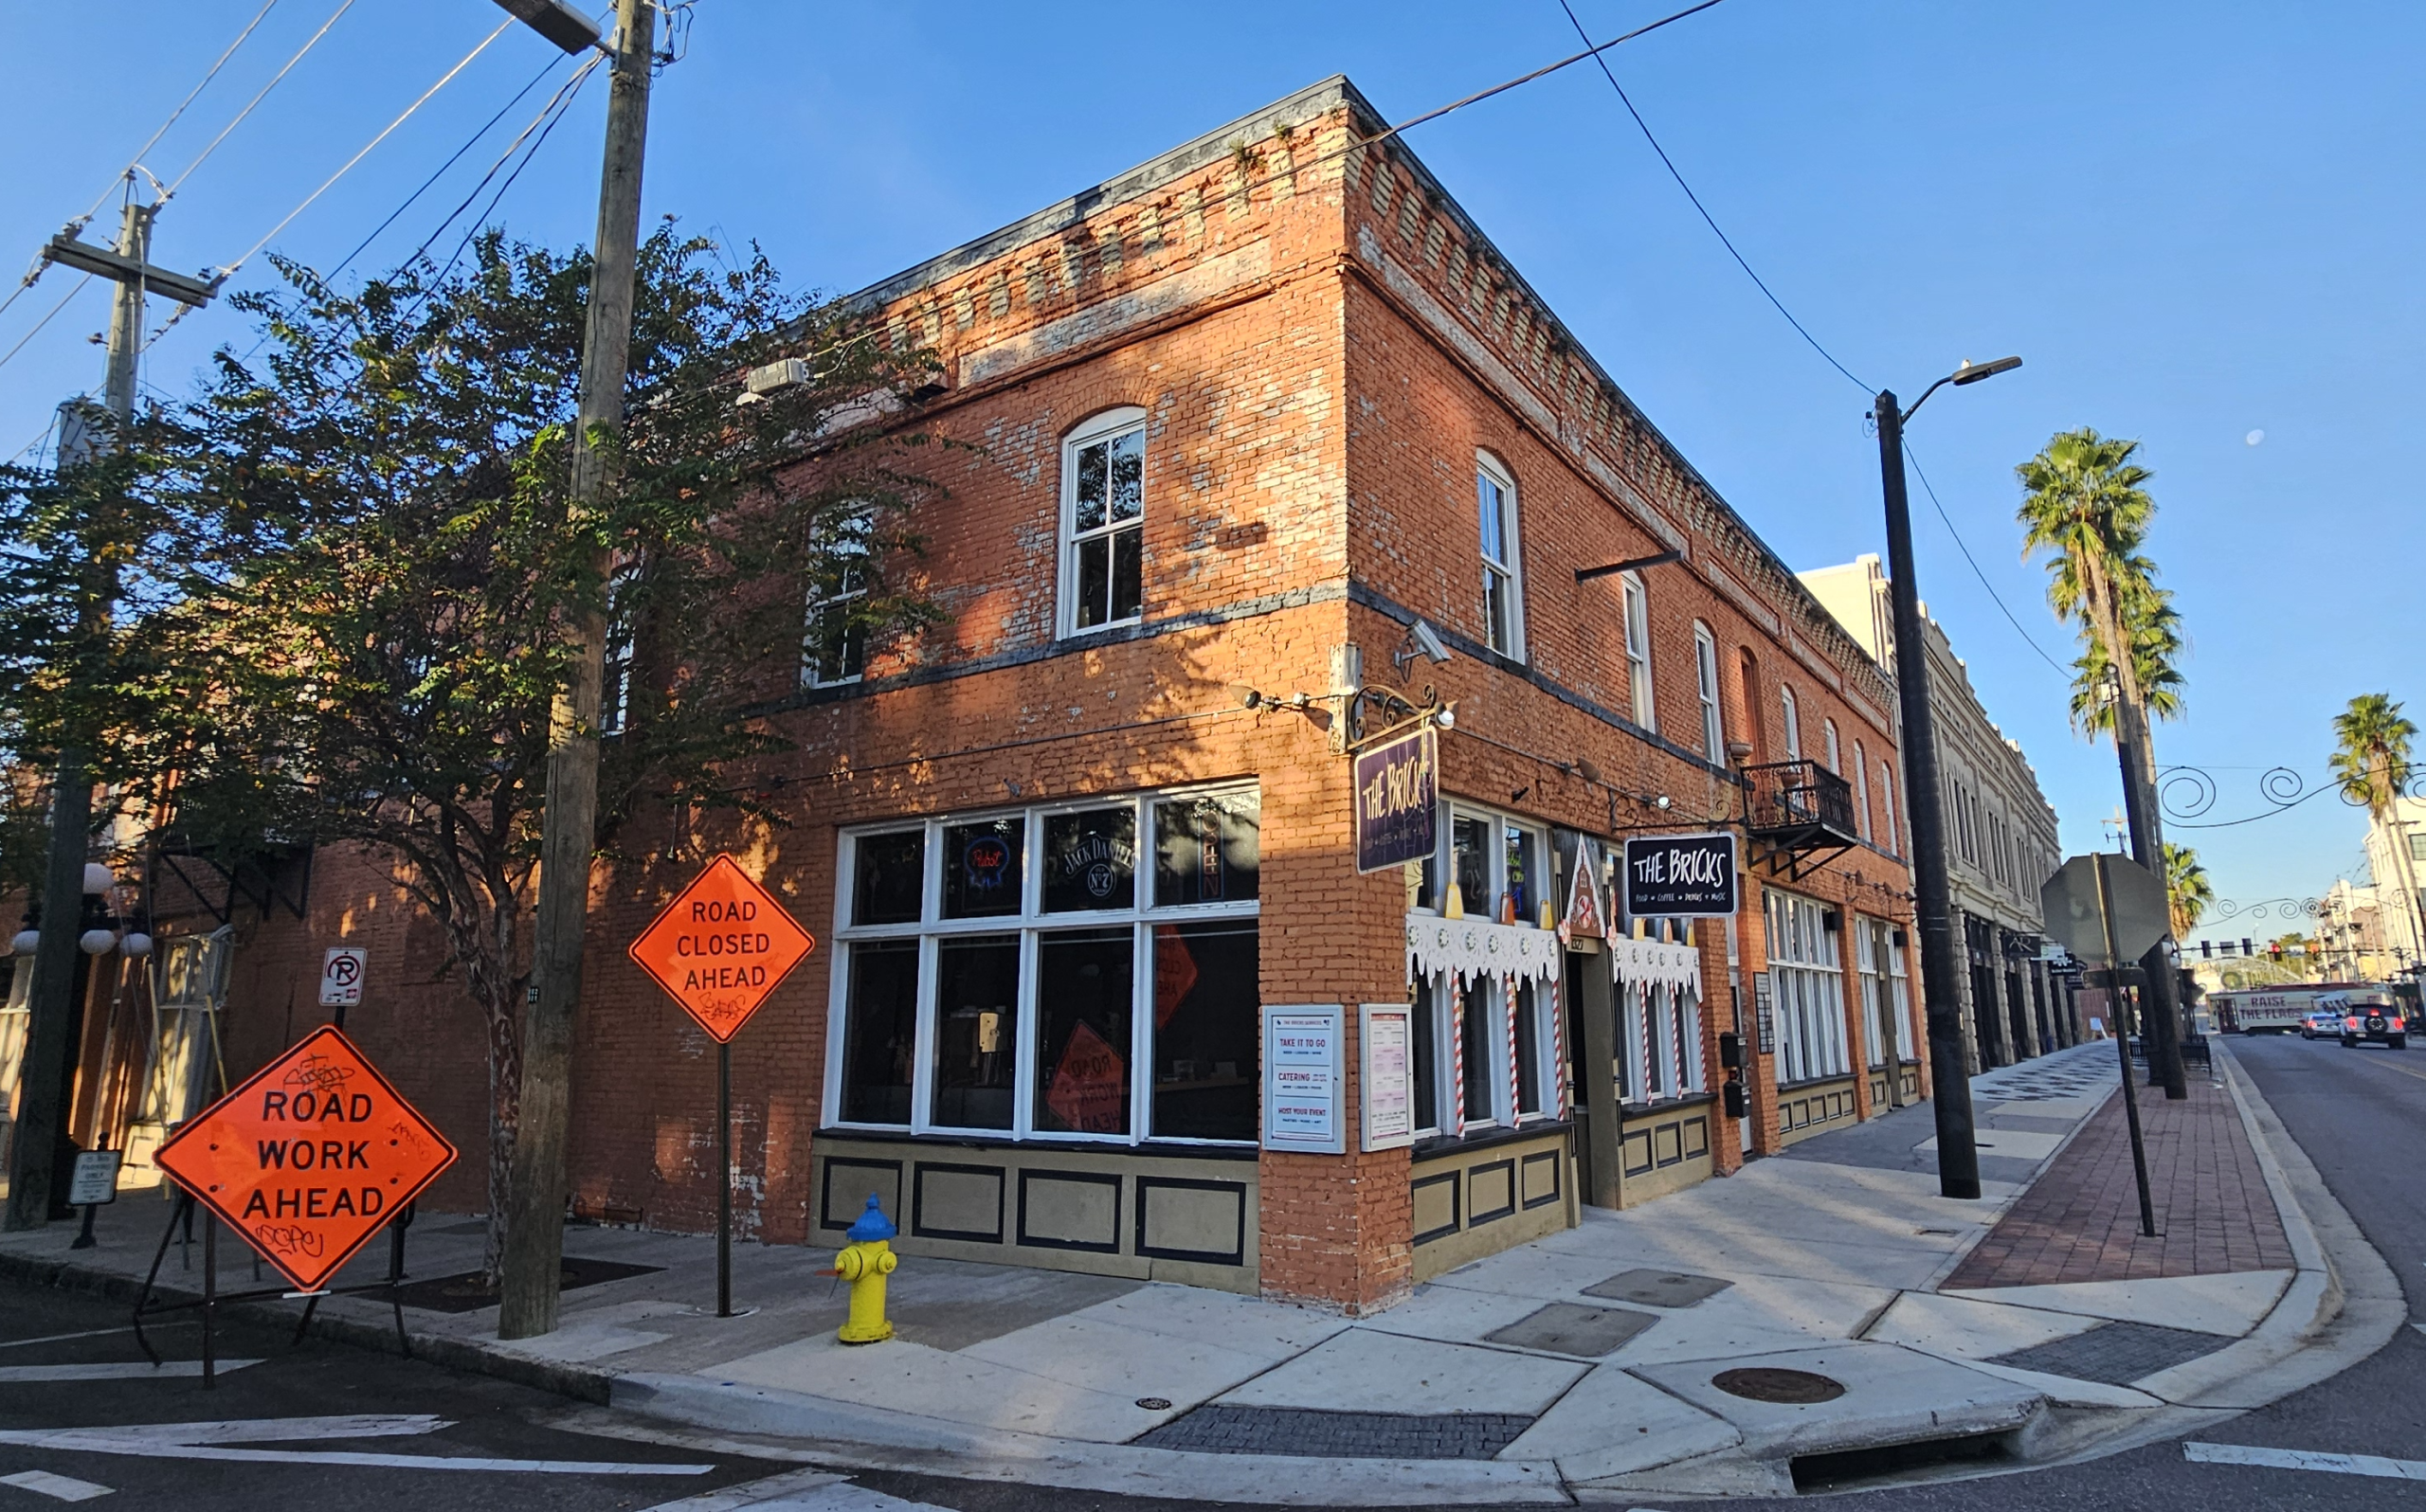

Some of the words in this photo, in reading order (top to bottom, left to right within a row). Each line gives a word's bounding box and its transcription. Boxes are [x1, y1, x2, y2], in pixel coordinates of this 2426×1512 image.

[1362, 770, 1386, 820] THE
[1064, 846, 1092, 874] JACK
[1202, 810, 1220, 896] OPEN
[1634, 852, 1666, 884] THE
[1669, 848, 1727, 888] BRICKS
[1636, 893, 1648, 903] FOOD
[1657, 892, 1675, 902] COFFEE
[1685, 892, 1703, 903] DRINKS
[693, 901, 757, 923] ROAD
[677, 933, 769, 957] CLOSED
[684, 965, 766, 991] AHEAD
[2239, 1009, 2261, 1020] THE
[2251, 996, 2287, 1008] RAISE
[1279, 1038, 1295, 1047] TAKE
[1297, 1038, 1304, 1047] IT
[1306, 1039, 1314, 1048] TO
[1315, 1039, 1326, 1048] GO
[1278, 1072, 1311, 1082] CATERING
[262, 1091, 372, 1123] ROAD
[257, 1140, 371, 1171] WORK
[241, 1187, 385, 1220] AHEAD
